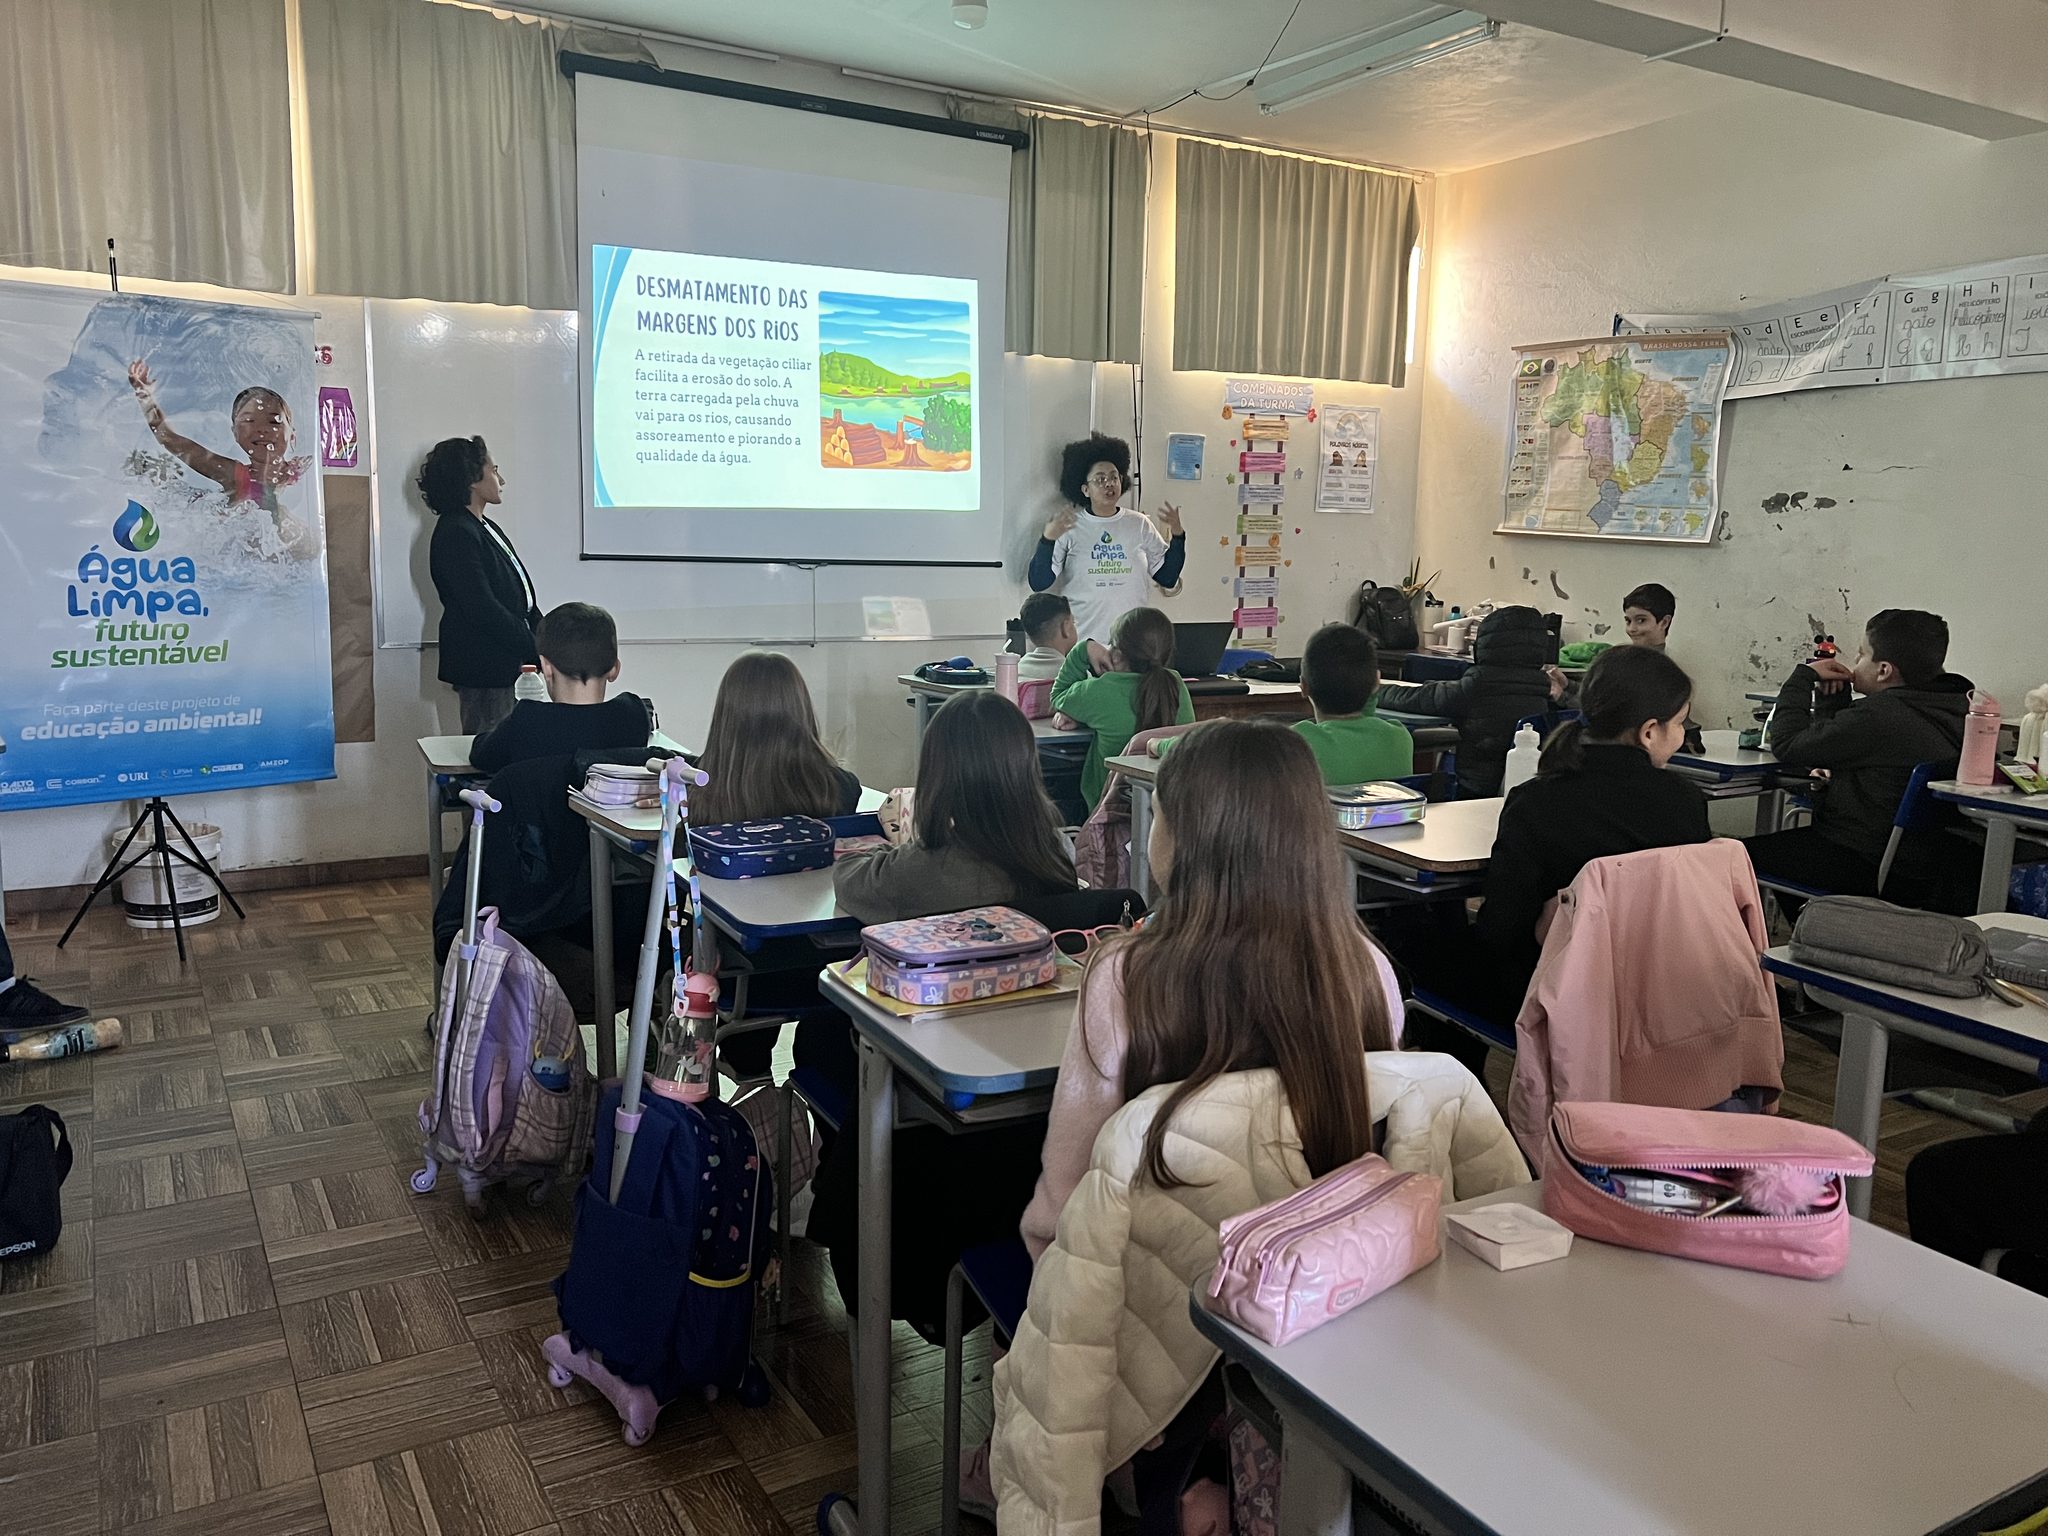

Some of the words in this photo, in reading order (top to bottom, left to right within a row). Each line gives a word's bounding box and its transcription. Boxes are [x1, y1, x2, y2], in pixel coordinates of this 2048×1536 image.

[636, 274, 771, 306] DESMATAMENTO
[778, 287, 808, 309] DAS
[1963, 284, 1973, 297] H
[1991, 281, 1999, 294] h
[1904, 292, 1914, 304] G
[1931, 291, 1939, 304] g
[1911, 305, 1929, 314] GATO
[637, 310, 717, 336] MARGENS
[725, 316, 756, 339] DOS
[1794, 317, 1803, 329] E
[1820, 312, 1829, 322] e
[1743, 327, 1751, 336] D
[1765, 323, 1773, 335] d
[635, 348, 645, 361] A
[648, 350, 698, 364] retirada
[701, 352, 716, 365] da
[718, 357, 779, 370] vegetação
[781, 358, 812, 370] ciliar
[635, 368, 678, 382] facilita
[681, 374, 689, 383] a
[691, 374, 733, 385] erosão
[736, 374, 751, 386] do
[753, 375, 781, 388] solo.
[783, 377, 793, 389] A
[1233, 382, 1304, 396] COMBINADOS
[635, 389, 667, 401] terra
[670, 392, 732, 406] carregada
[735, 393, 761, 408] pela
[763, 395, 799, 408] chuva
[1240, 397, 1256, 408] DA
[1259, 398, 1296, 410] TURMA
[635, 408, 654, 421] vai
[657, 412, 685, 424] para
[688, 413, 702, 423] os
[705, 412, 732, 426] rios,
[735, 414, 792, 426] causando
[635, 431, 725, 443] assoreamento
[728, 434, 735, 443] e
[738, 432, 792, 446] piorando
[794, 436, 801, 446] a
[635, 449, 698, 463] qualidade
[701, 450, 716, 463] da
[719, 451, 751, 465] água.
[1093, 543, 1123, 553] Água
[77, 544, 196, 591] Água
[1087, 566, 1133, 575] sustentável
[1097, 559, 1122, 568] futuro
[67, 584, 209, 623] Limpa,
[95, 618, 190, 642] futuro
[51, 640, 229, 668] sustentável
[43, 703, 80, 718] Faça
[83, 702, 124, 717] parte
[127, 700, 169, 713] deste
[171, 696, 220, 712] projeto
[222, 694, 241, 706] de
[20, 716, 140, 740] educação
[143, 708, 262, 732] ambiental!
[129, 772, 149, 781] URI
[0, 1240, 36, 1256] EPSON
